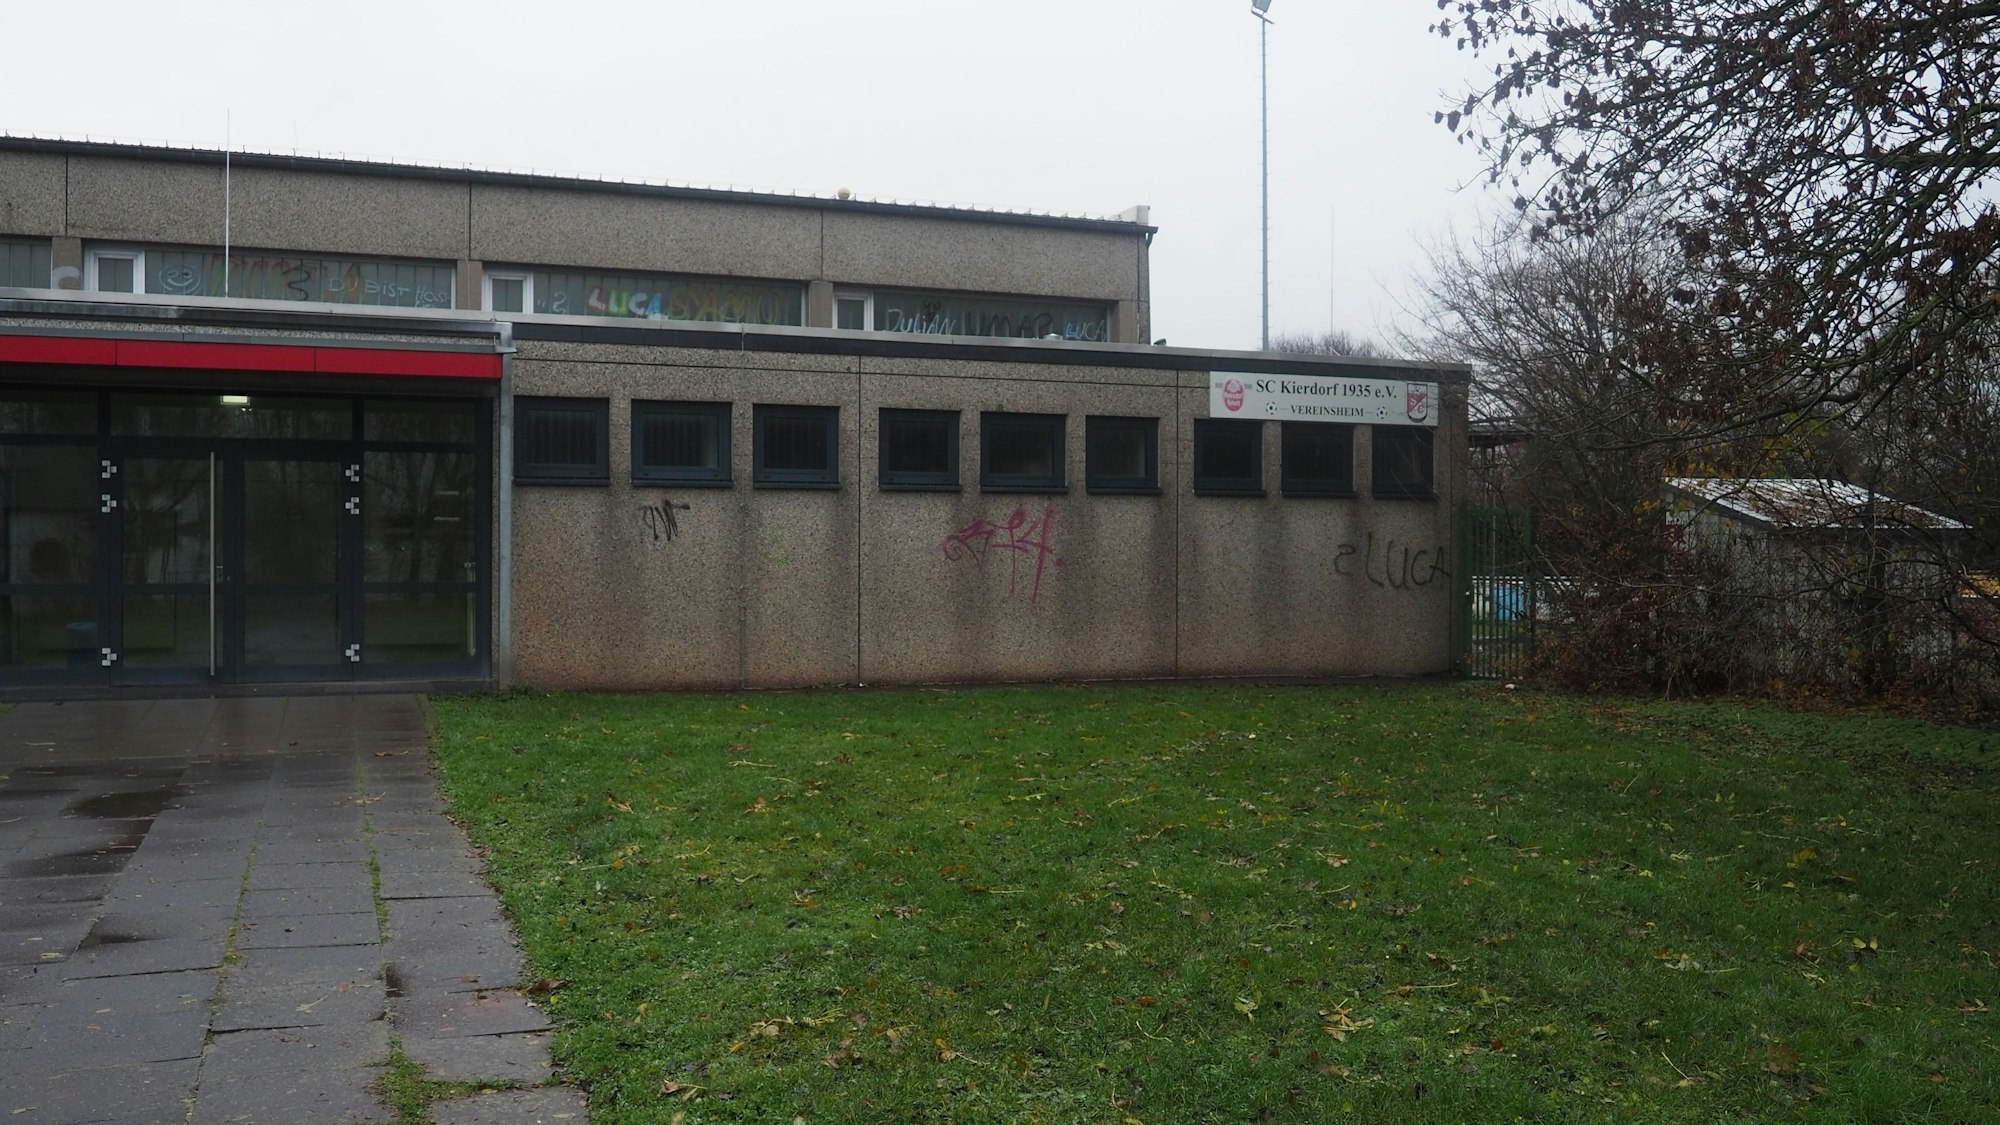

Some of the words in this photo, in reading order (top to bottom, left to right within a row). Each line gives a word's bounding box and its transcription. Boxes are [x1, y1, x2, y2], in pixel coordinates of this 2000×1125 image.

[1256, 379, 1277, 393] SC
[1280, 380, 1340, 397] Kierdorf
[1343, 383, 1371, 398] 1935
[1374, 386, 1397, 399] e.V.
[1290, 405, 1364, 417] VEREINSHEIM
[1365, 532, 1451, 590] LUCA
